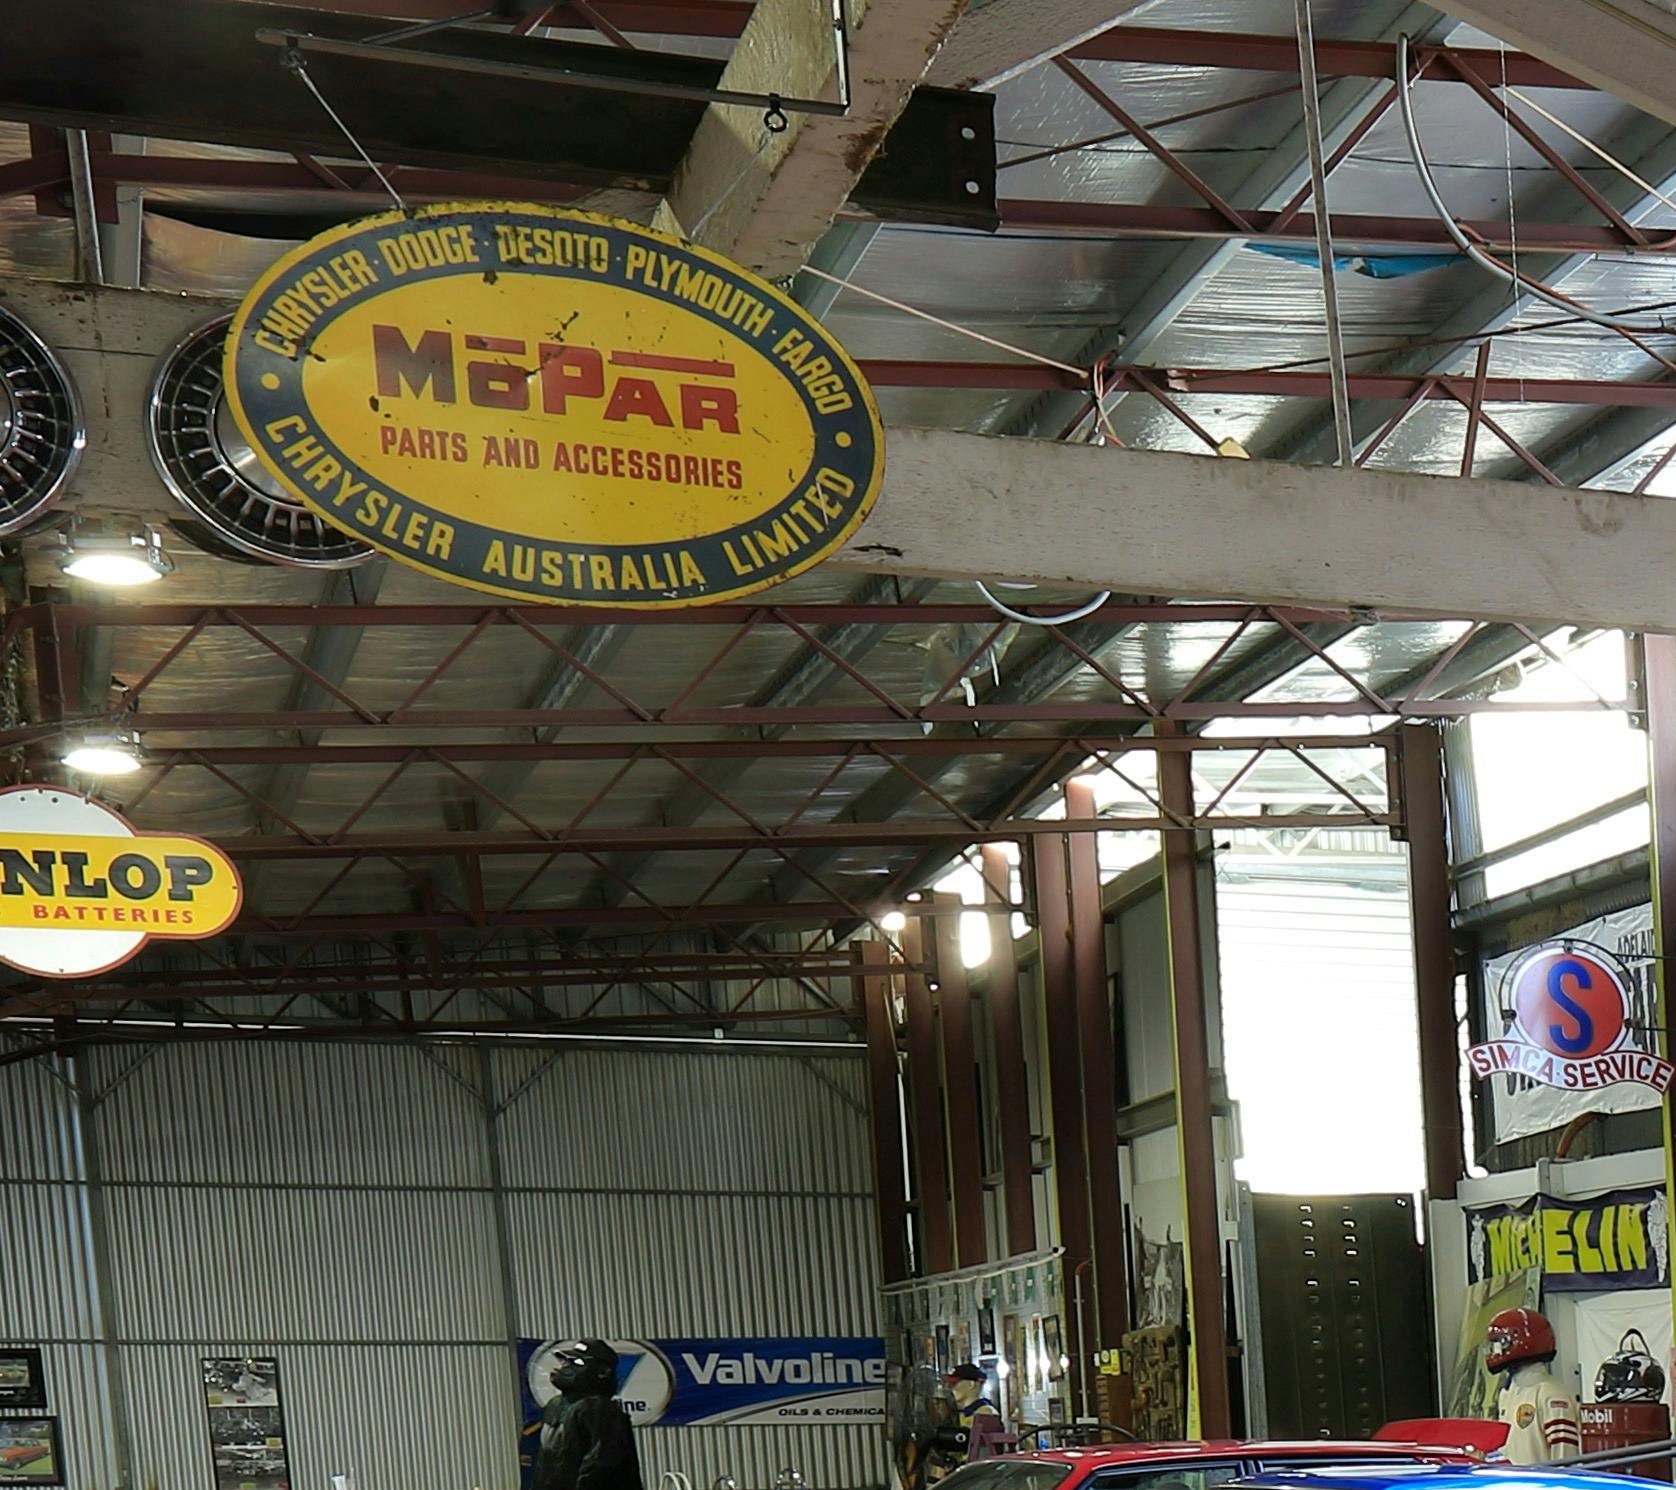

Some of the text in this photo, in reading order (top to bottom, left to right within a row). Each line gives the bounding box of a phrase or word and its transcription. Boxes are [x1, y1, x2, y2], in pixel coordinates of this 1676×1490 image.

[254, 224, 851, 417] CHRYSLER DODGE DESOTO PLYMOUTH FARGO
[380, 426, 743, 492] PARTS AND ACCESSORIES
[263, 413, 856, 591] CHRYSLER AUSTRALIA LIMITED
[32, 901, 195, 926] BATTERIES
[1548, 961, 1593, 1053] S
[1472, 1048, 1672, 1090] SIMCA SERVICE
[1488, 1203, 1646, 1275] MICHELIN
[682, 1353, 885, 1384] Valvoline
[778, 1408, 809, 1416] OILS
[812, 1408, 822, 1416] &
[1581, 1409, 1612, 1423] Mobil
